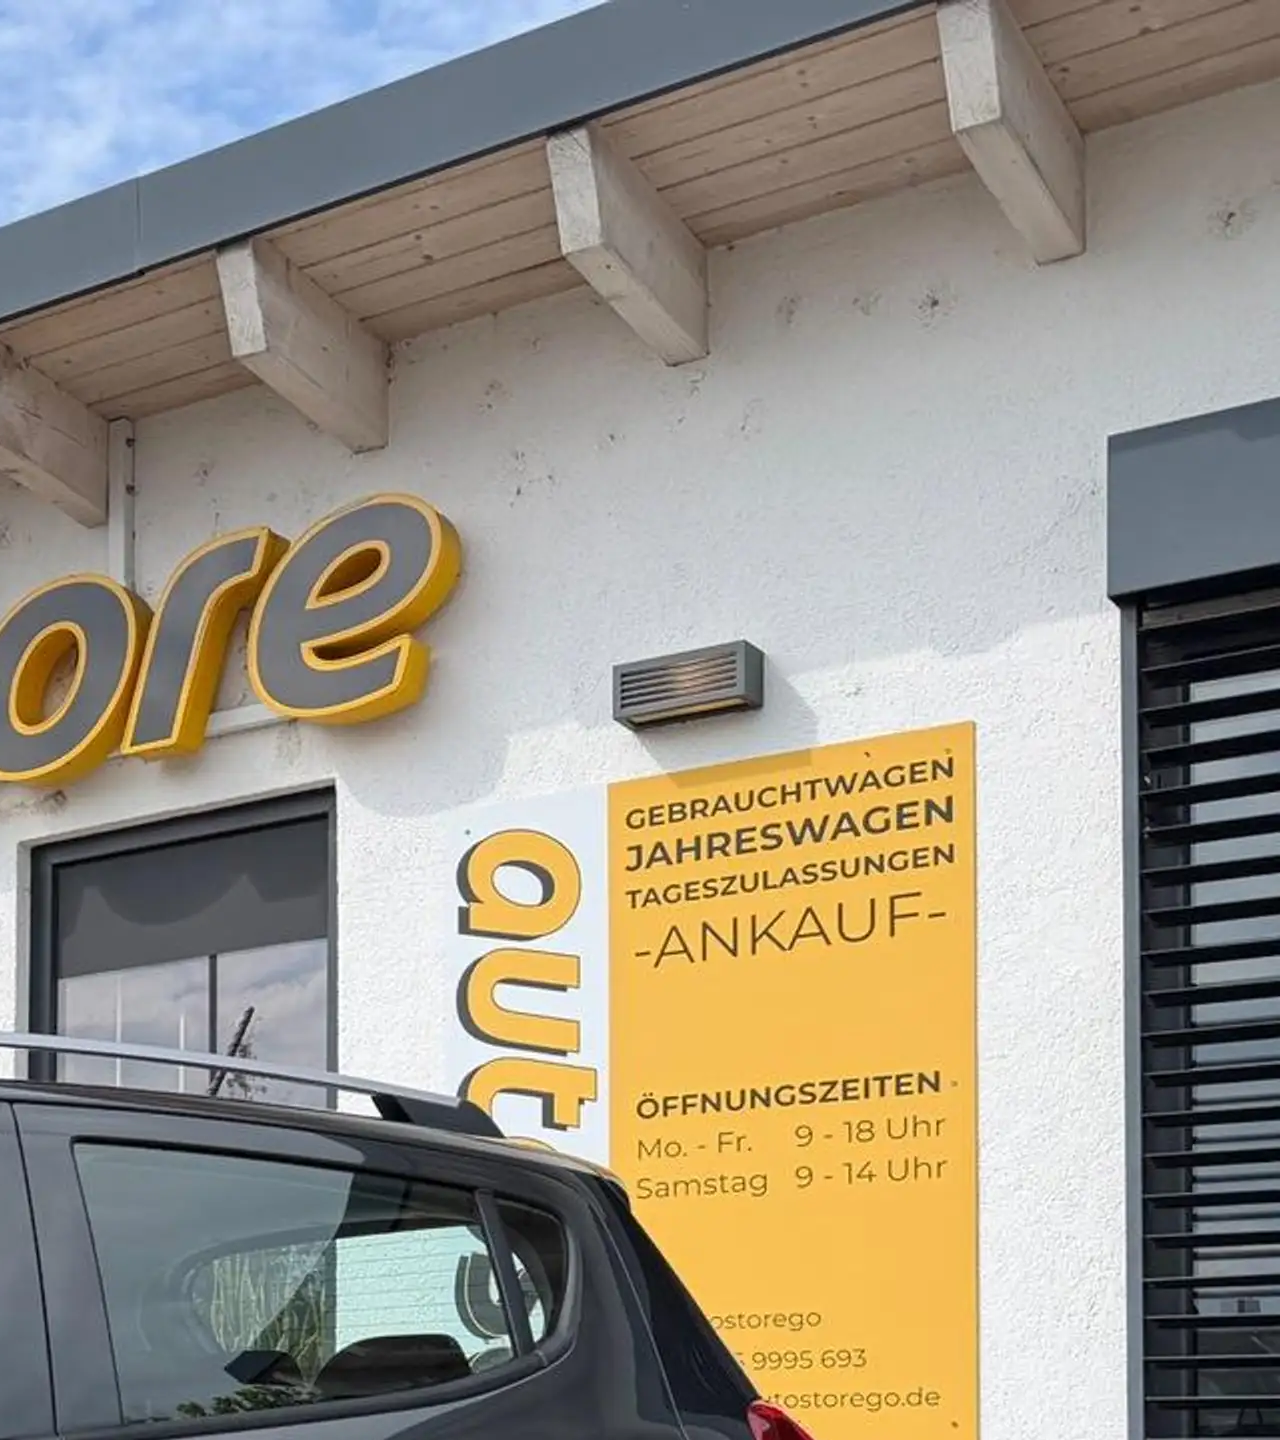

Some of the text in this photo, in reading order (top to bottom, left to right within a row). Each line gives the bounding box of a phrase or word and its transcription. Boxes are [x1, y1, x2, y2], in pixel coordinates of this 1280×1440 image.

[625, 756, 954, 830] GEBRAUCHTWAGEN
[625, 795, 954, 872] JAHRESWAGEN
[625, 843, 955, 909] TAGESZULASSUNGEN
[634, 891, 947, 969] -ANKAUF-
[636, 1070, 941, 1120] ÖFFNUNGSZEITEN
[637, 1138, 688, 1161] Mo.
[717, 1131, 752, 1154] Fr.
[794, 1124, 814, 1148] 9
[843, 1119, 876, 1144] 18
[886, 1114, 946, 1140] Uhr
[636, 1174, 768, 1199] Samstag
[795, 1165, 814, 1189] 9
[843, 1160, 878, 1185] 14
[887, 1155, 948, 1181] Uhr
[751, 1350, 814, 1371] 9995
[820, 1348, 867, 1369] 693
